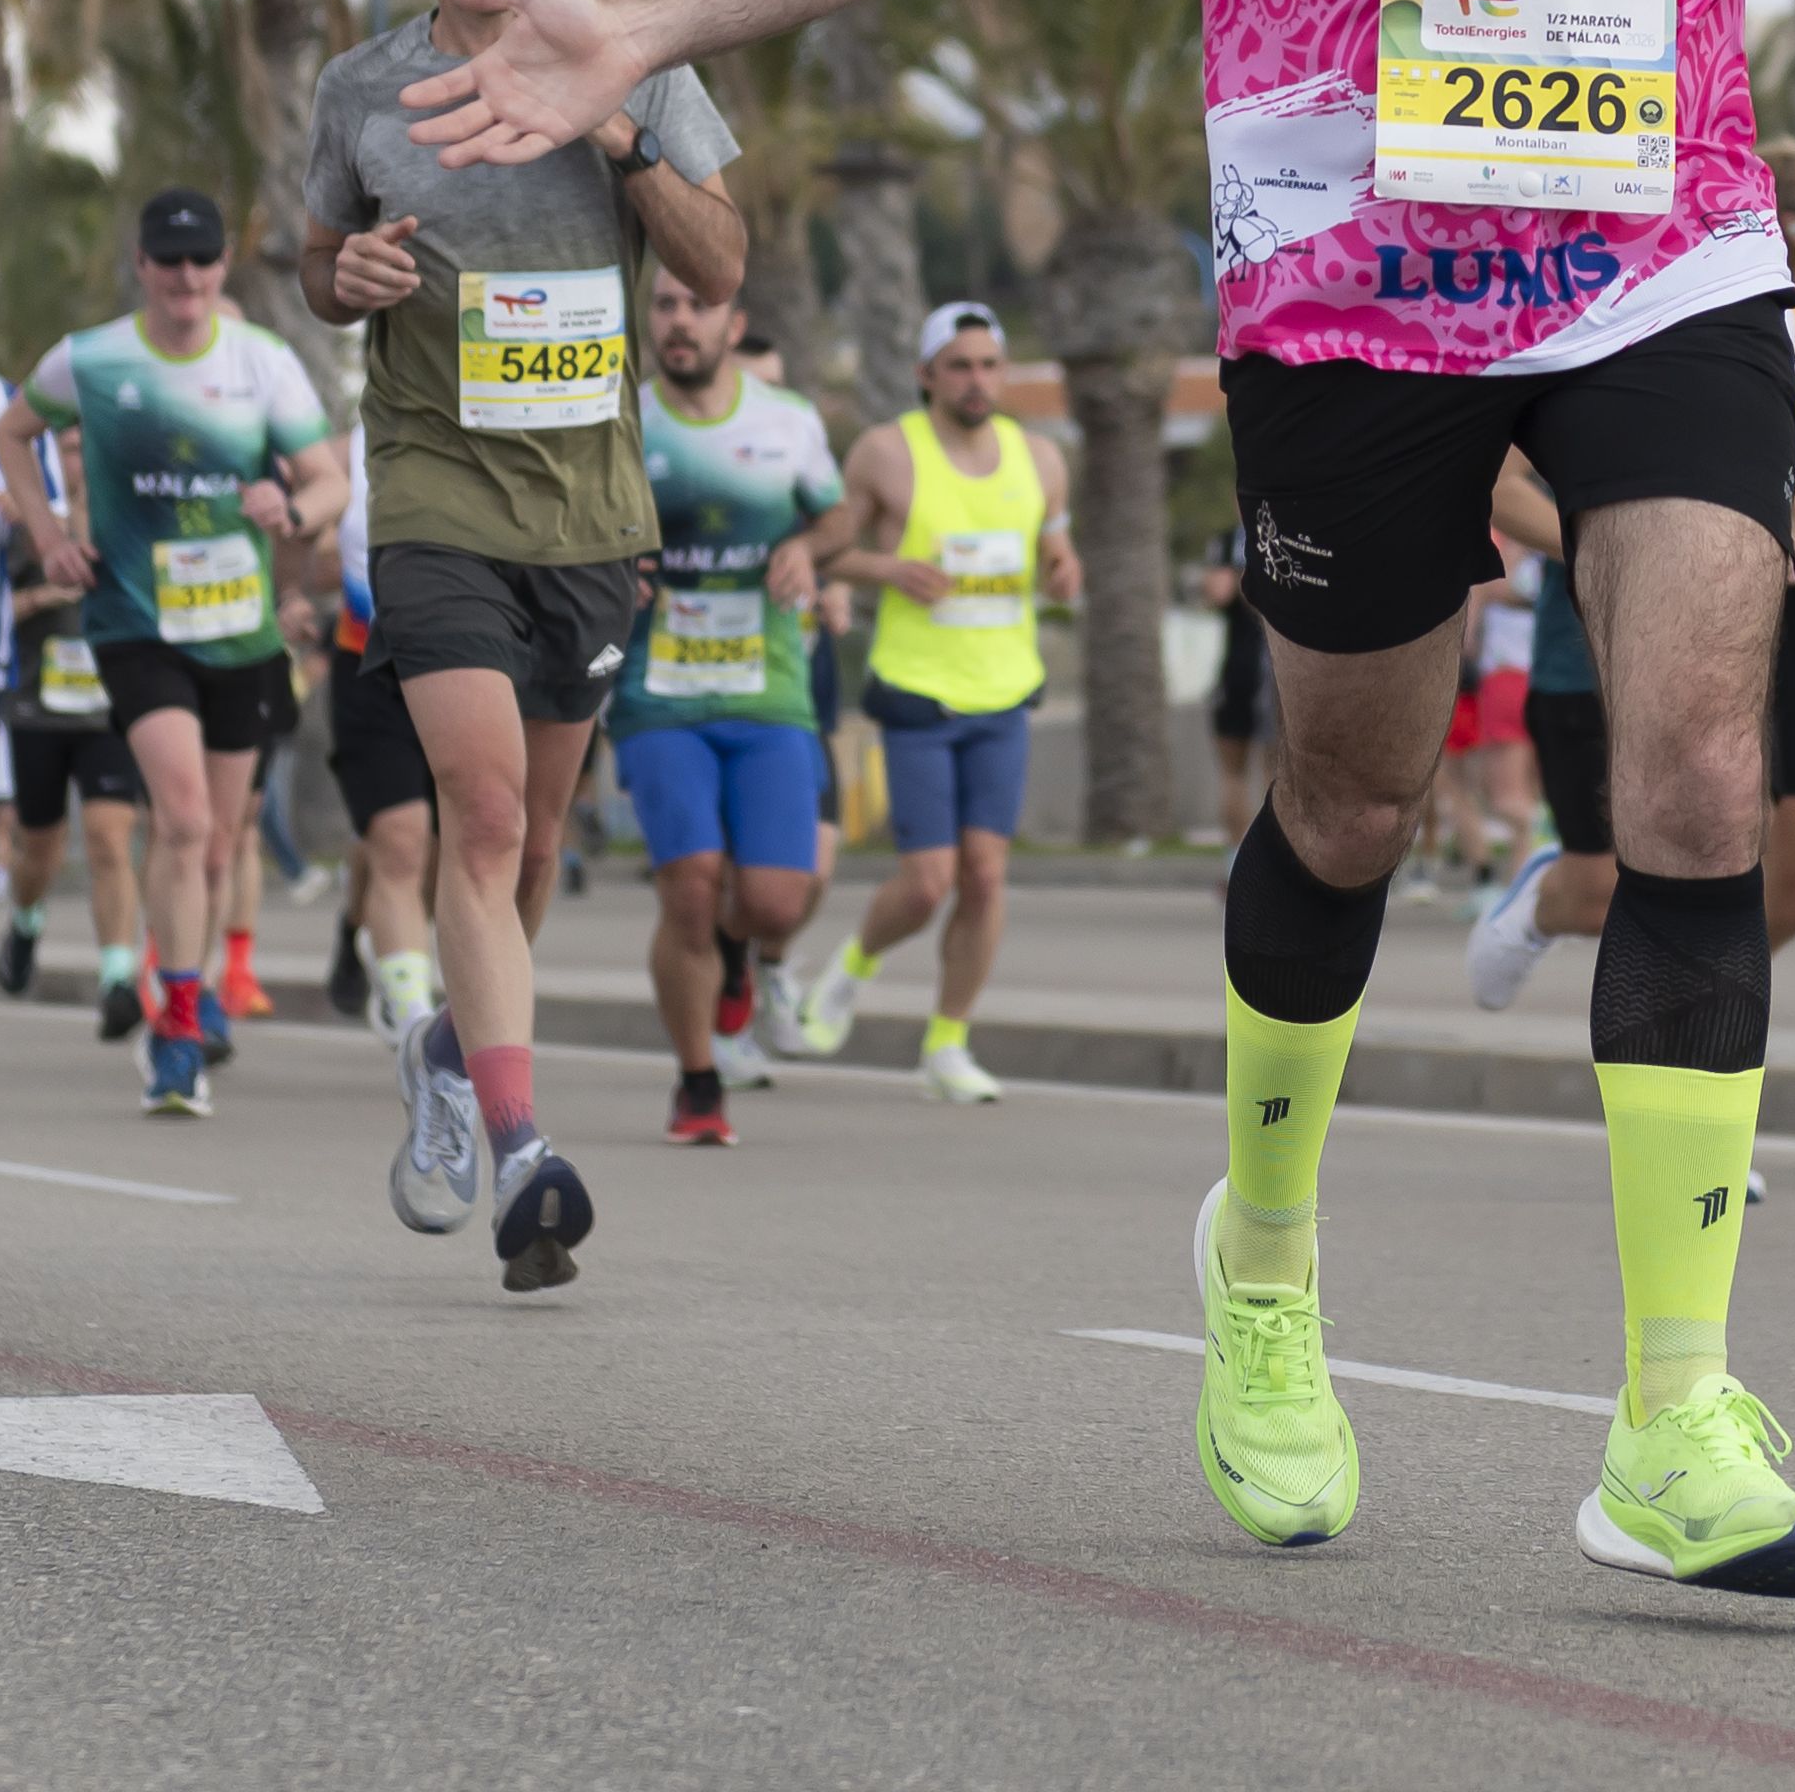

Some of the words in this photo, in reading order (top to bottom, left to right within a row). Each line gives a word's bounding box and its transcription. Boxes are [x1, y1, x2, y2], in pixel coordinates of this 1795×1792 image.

[1547, 13, 1567, 26] 1/2
[1570, 14, 1631, 29] MARATÓN
[1435, 24, 1527, 41] TotalEnergies
[1546, 30, 1563, 42] DE
[1567, 30, 1620, 45] MÁLAGA
[1442, 67, 1627, 135] 2626
[1495, 136, 1567, 151] Montalban
[1280, 167, 1300, 178] C.D.
[1254, 177, 1328, 192] LUMICIERNAGA
[1374, 231, 1621, 308] LUMIS
[500, 342, 603, 383] 5482
